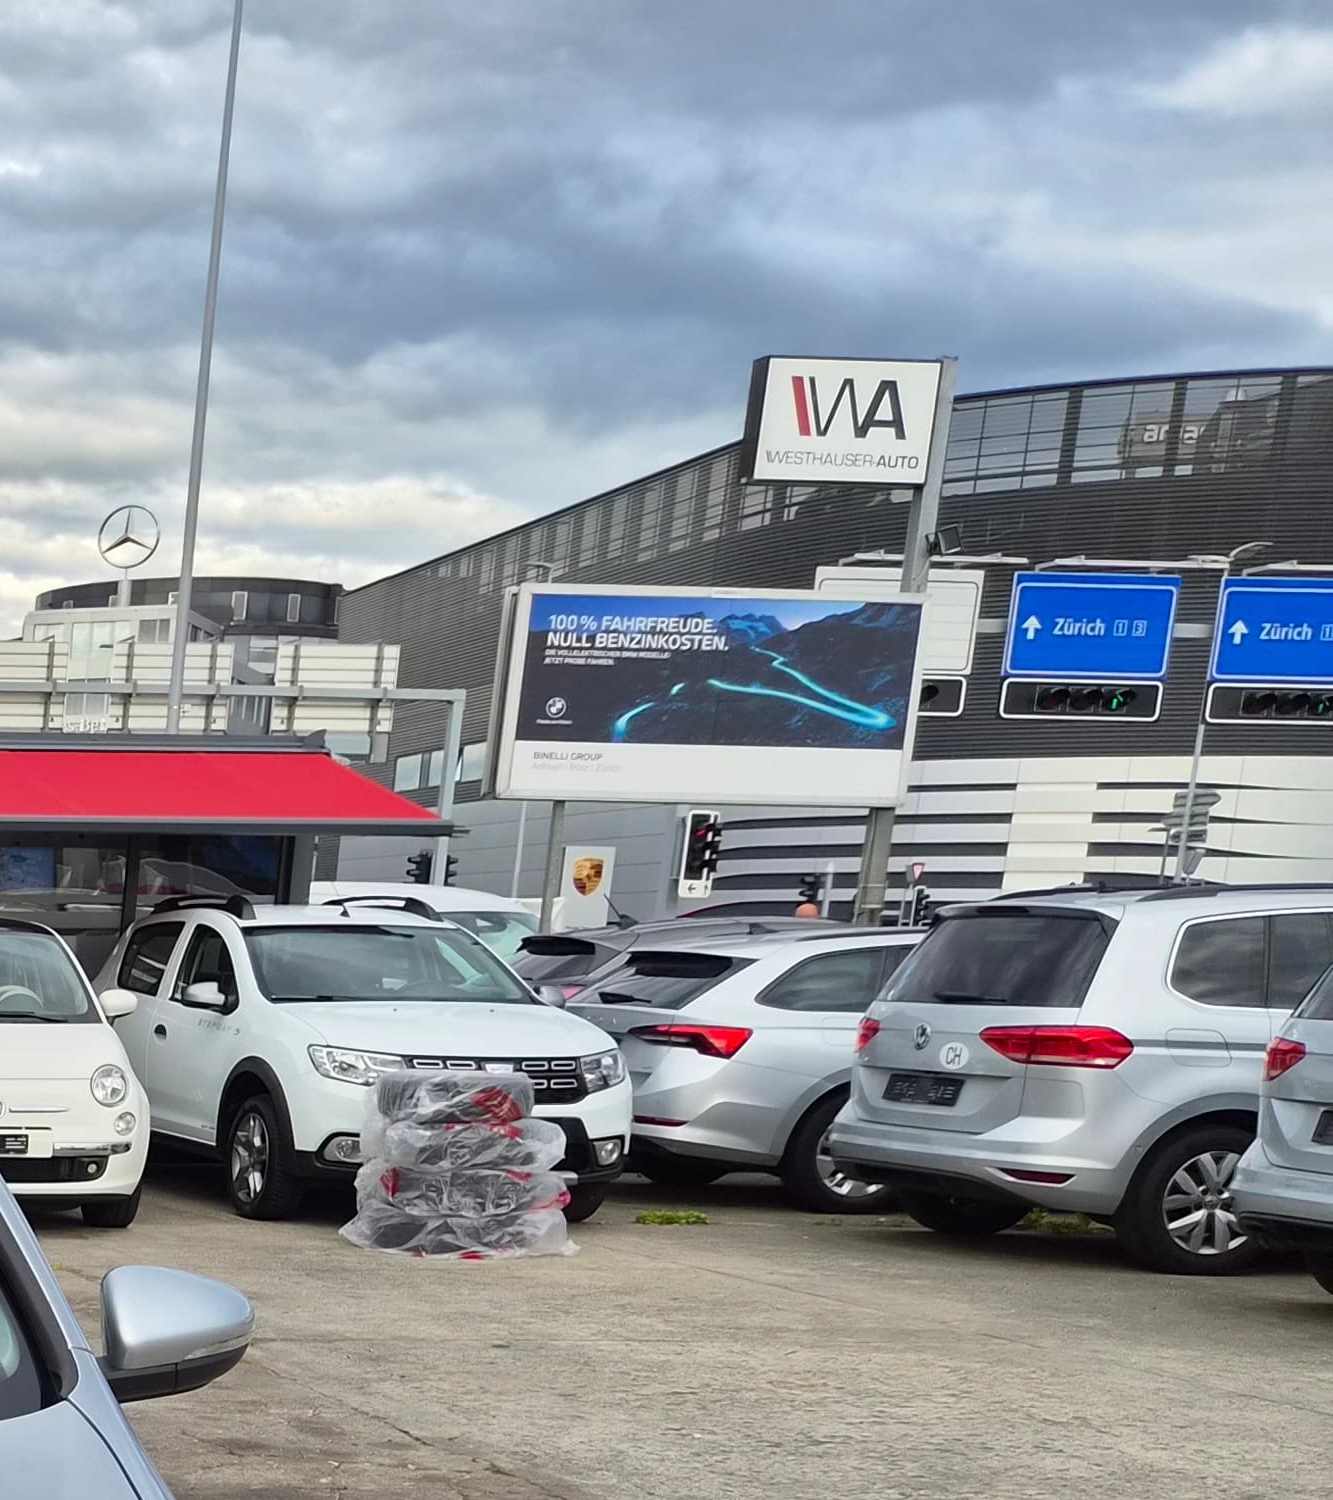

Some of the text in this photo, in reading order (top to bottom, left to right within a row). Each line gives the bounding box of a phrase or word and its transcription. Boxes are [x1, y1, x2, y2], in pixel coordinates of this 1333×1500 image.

[548, 614, 718, 633] 100 % FAHRFREUDE.
[1053, 618, 1106, 636] Zürich
[1259, 622, 1313, 640] Zürich
[547, 631, 729, 651] NULL BENZINKOSTEN.
[946, 1046, 963, 1065] CH
